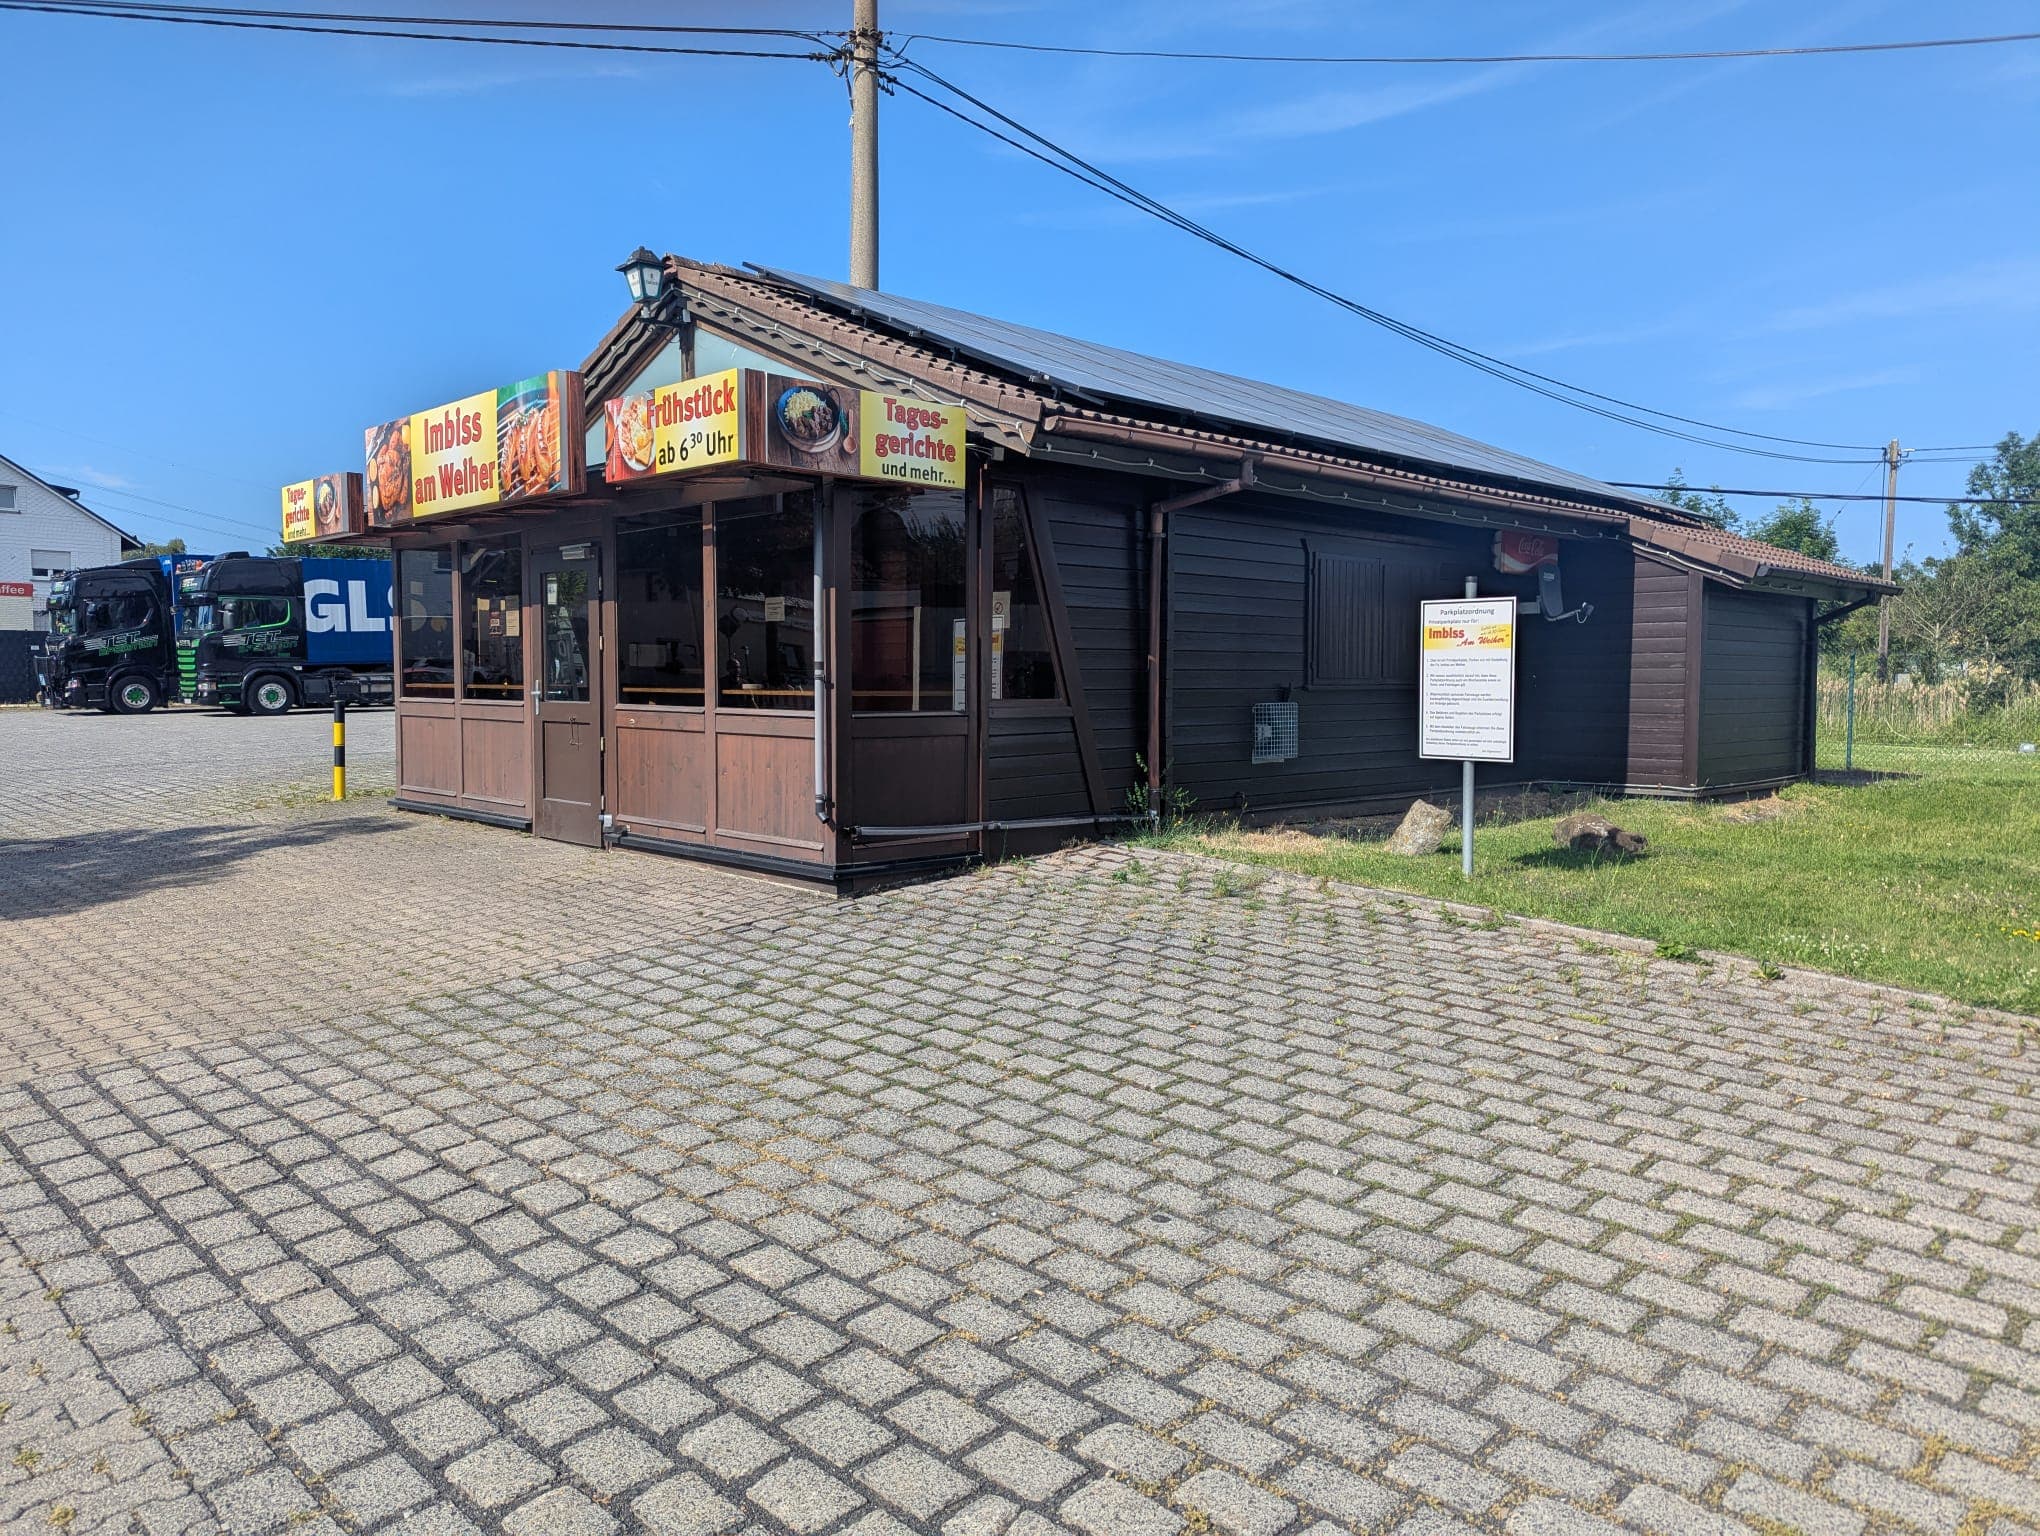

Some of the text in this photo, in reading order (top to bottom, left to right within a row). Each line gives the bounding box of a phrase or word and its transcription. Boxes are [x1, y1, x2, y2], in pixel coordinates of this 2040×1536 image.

[647, 378, 736, 430] Frühstück
[883, 397, 948, 430] Tages-
[424, 407, 482, 455] Imbiss
[659, 440, 675, 466] ab
[706, 430, 734, 456] Uhr
[875, 432, 956, 462] gerichte
[415, 456, 496, 504] am Weiher
[882, 462, 955, 484] und mehr...
[287, 488, 306, 505] Tages-
[285, 506, 310, 528] gerichte
[0, 584, 25, 595] ffee
[1440, 608, 1495, 616] Parkplatzordnung
[240, 630, 281, 646] TET
[1428, 627, 1465, 639] Imbiss
